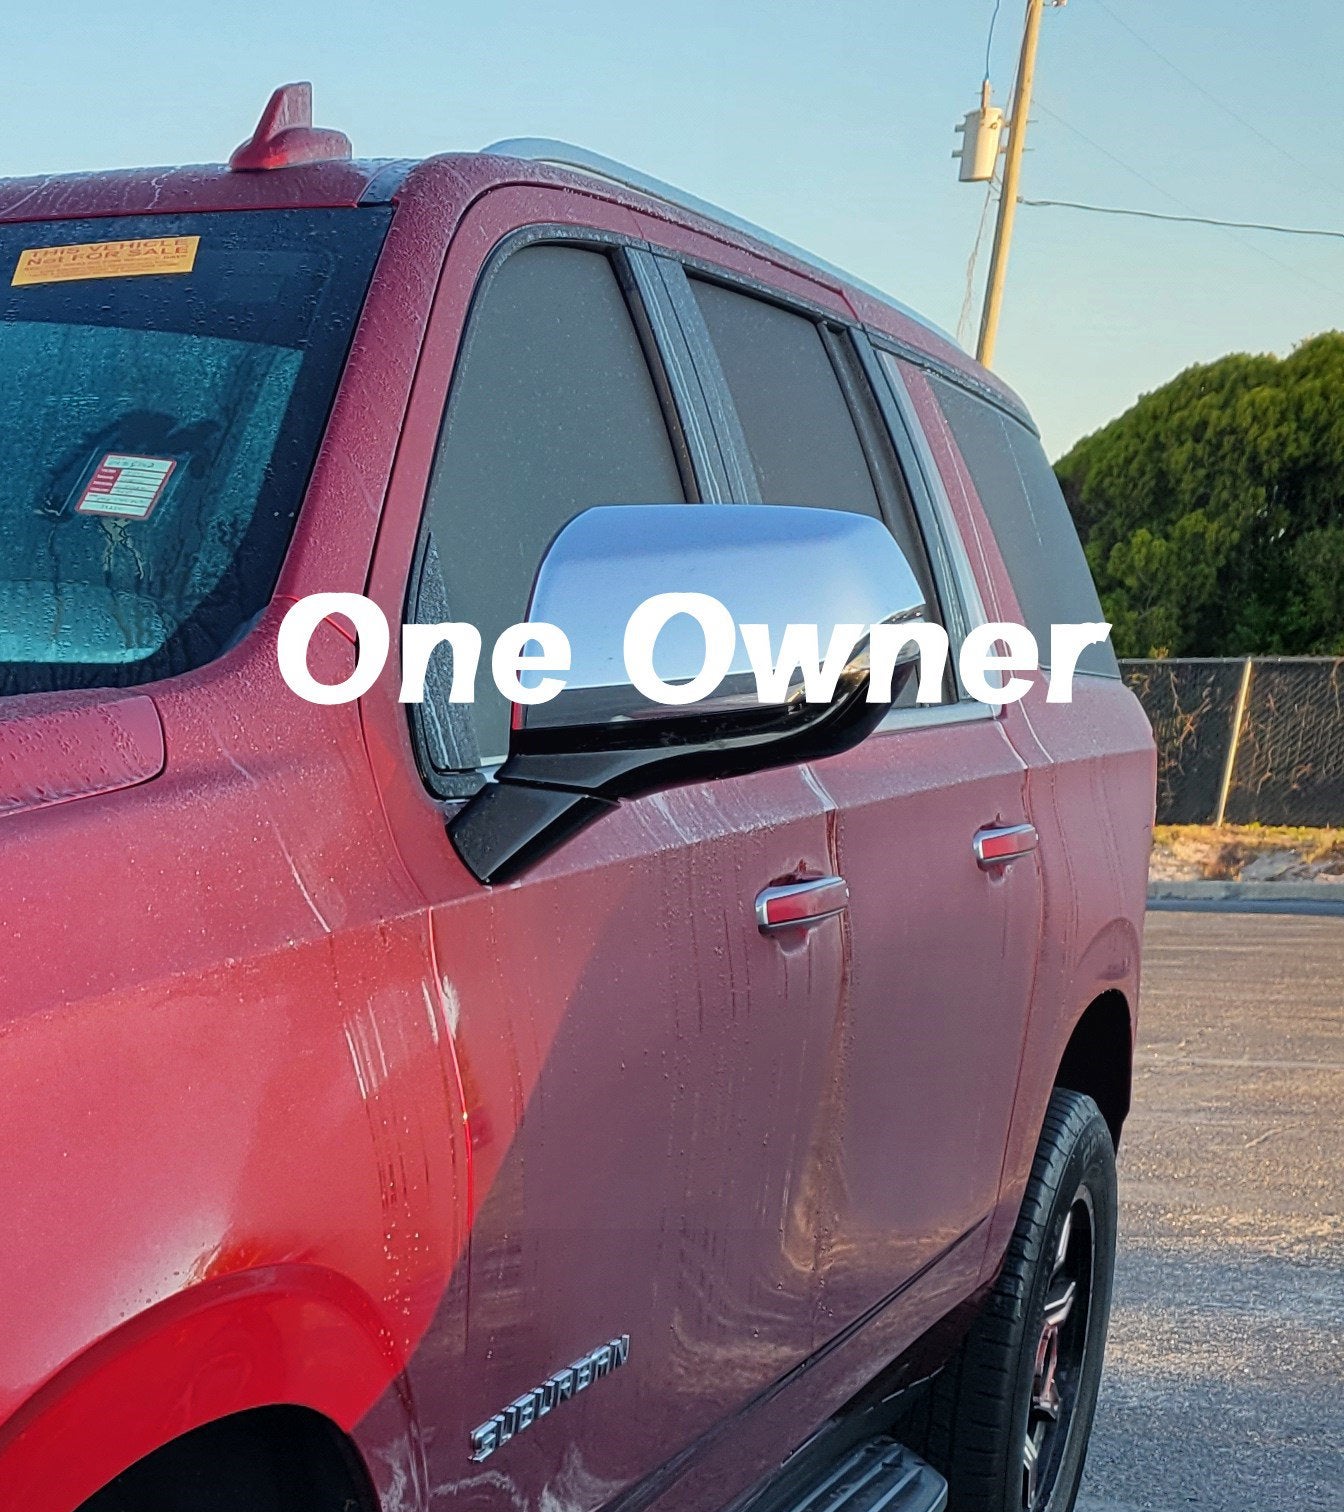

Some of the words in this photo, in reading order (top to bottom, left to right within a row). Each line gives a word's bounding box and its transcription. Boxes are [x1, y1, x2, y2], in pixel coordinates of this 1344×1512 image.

[71, 250, 120, 262] FOR
[127, 246, 189, 257] SALE
[468, 1334, 630, 1463] SUBURBAN
